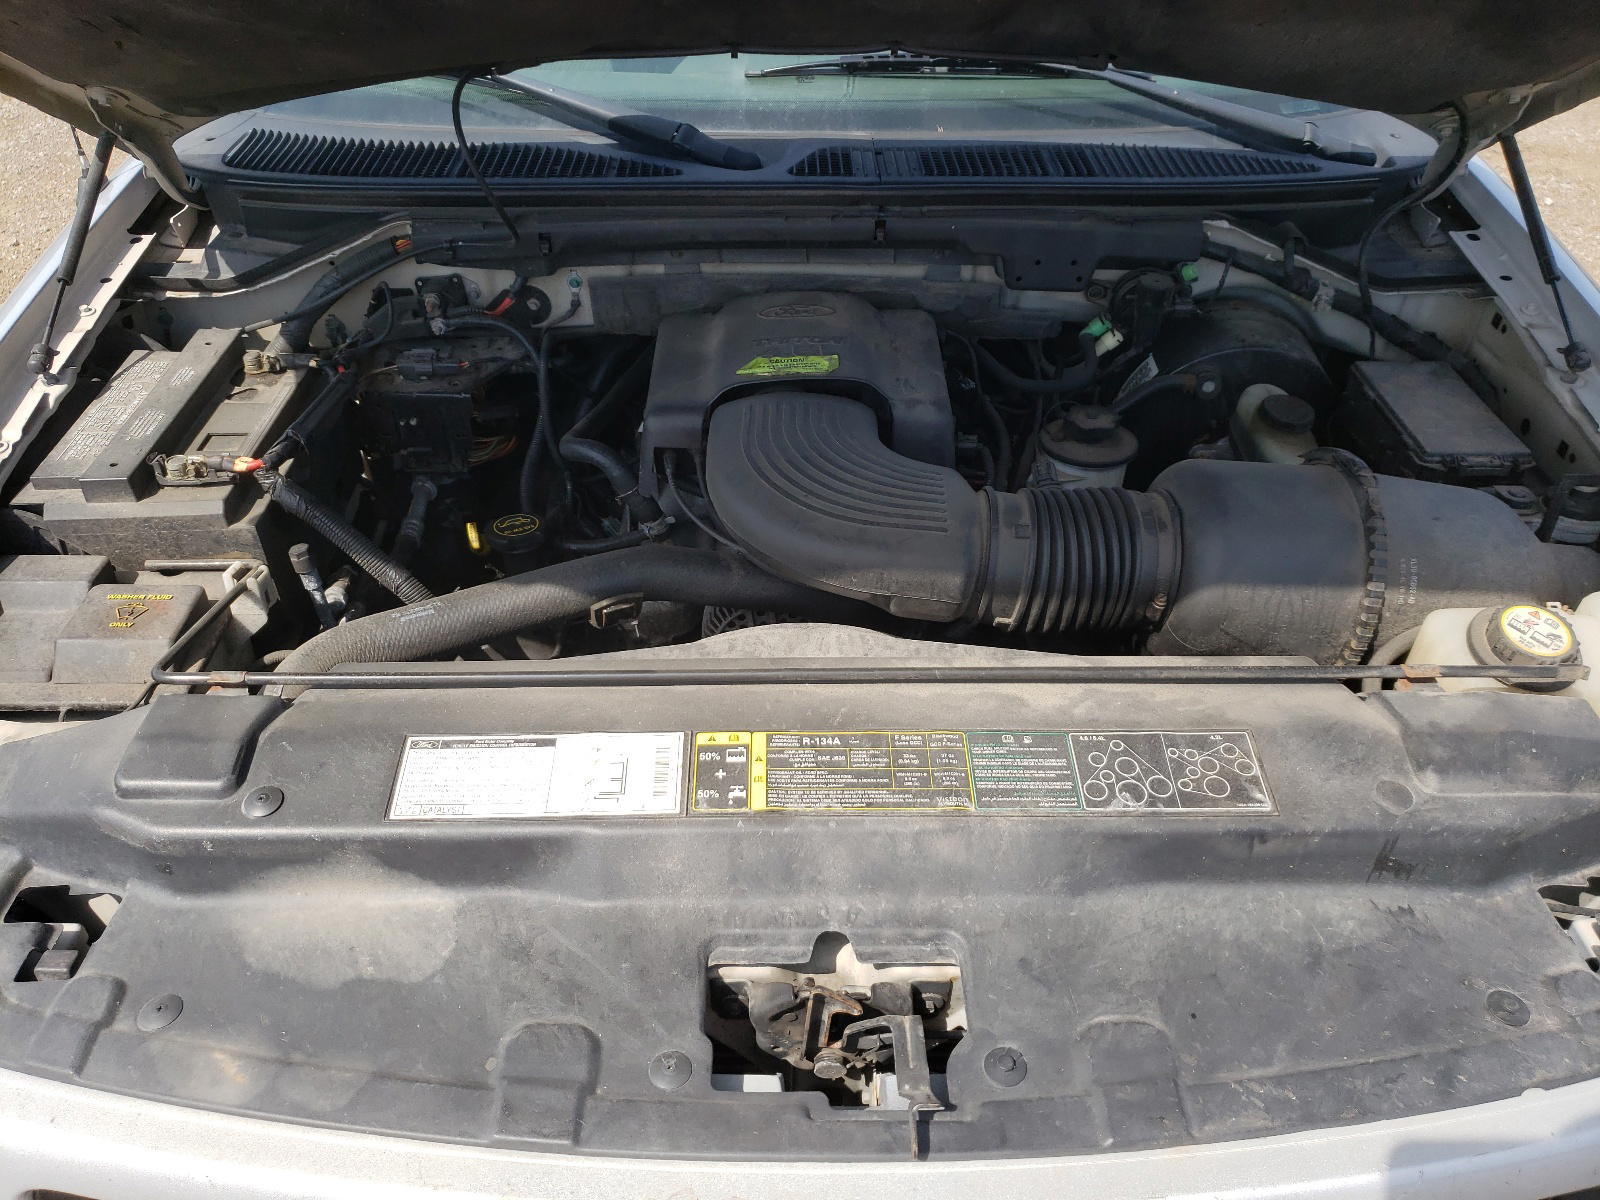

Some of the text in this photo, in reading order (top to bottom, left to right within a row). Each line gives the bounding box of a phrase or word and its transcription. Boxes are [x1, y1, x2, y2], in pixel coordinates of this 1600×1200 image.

[802, 737, 841, 746] R-134A
[699, 752, 721, 760] 50%
[696, 790, 720, 798] 50%
